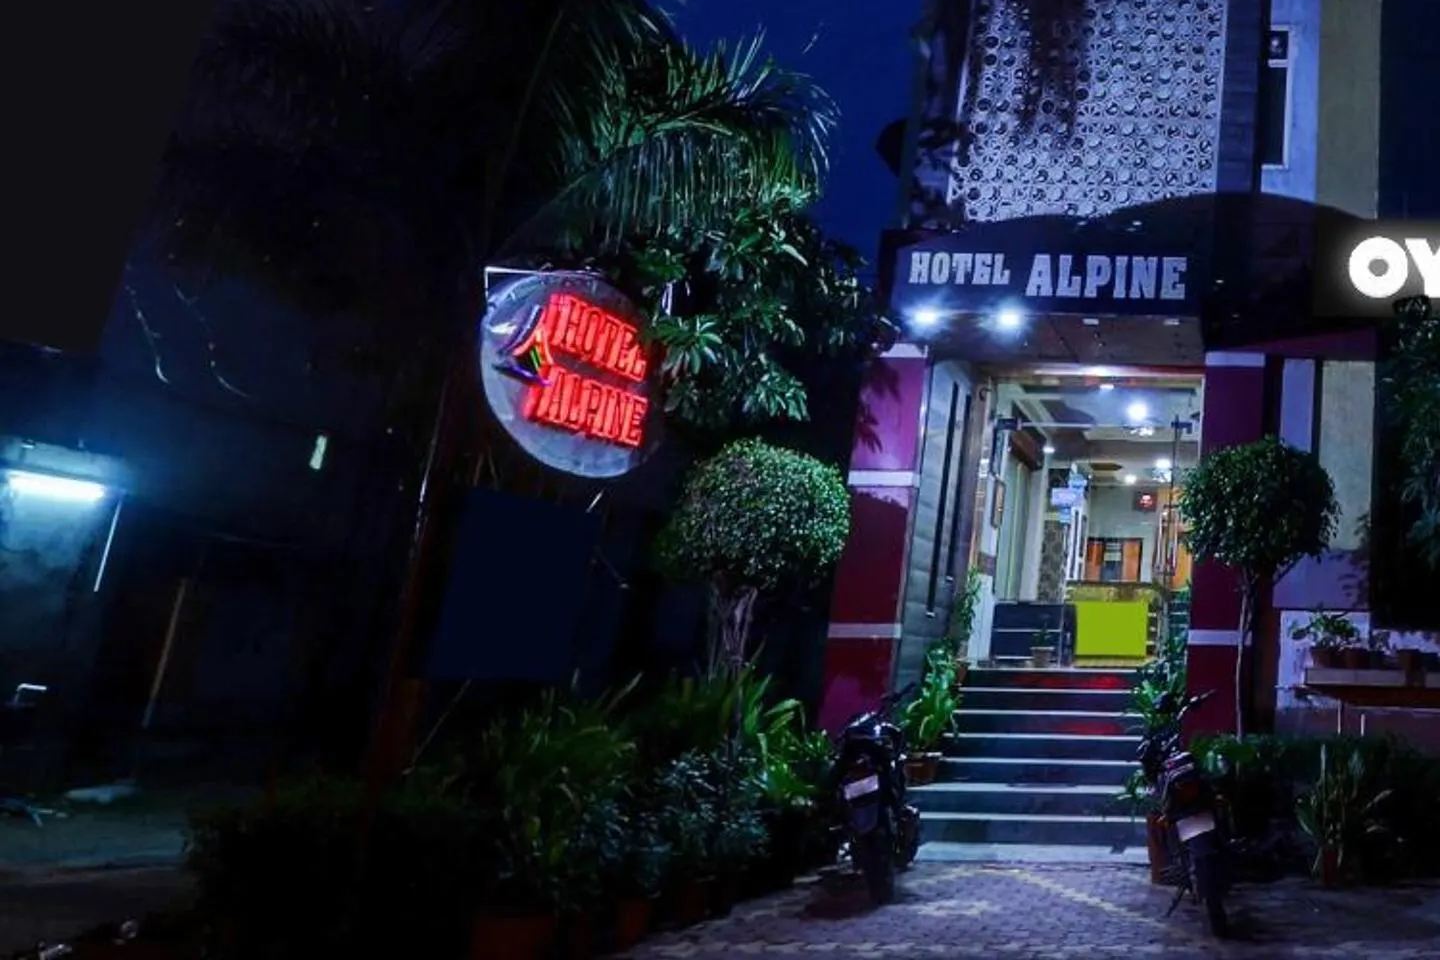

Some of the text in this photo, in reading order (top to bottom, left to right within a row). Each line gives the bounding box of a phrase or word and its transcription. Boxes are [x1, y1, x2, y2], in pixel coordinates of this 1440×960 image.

[908, 251, 1188, 300] HOTEL ALPINE
[541, 293, 648, 382] HOTEL
[526, 367, 649, 448] ALPINE
